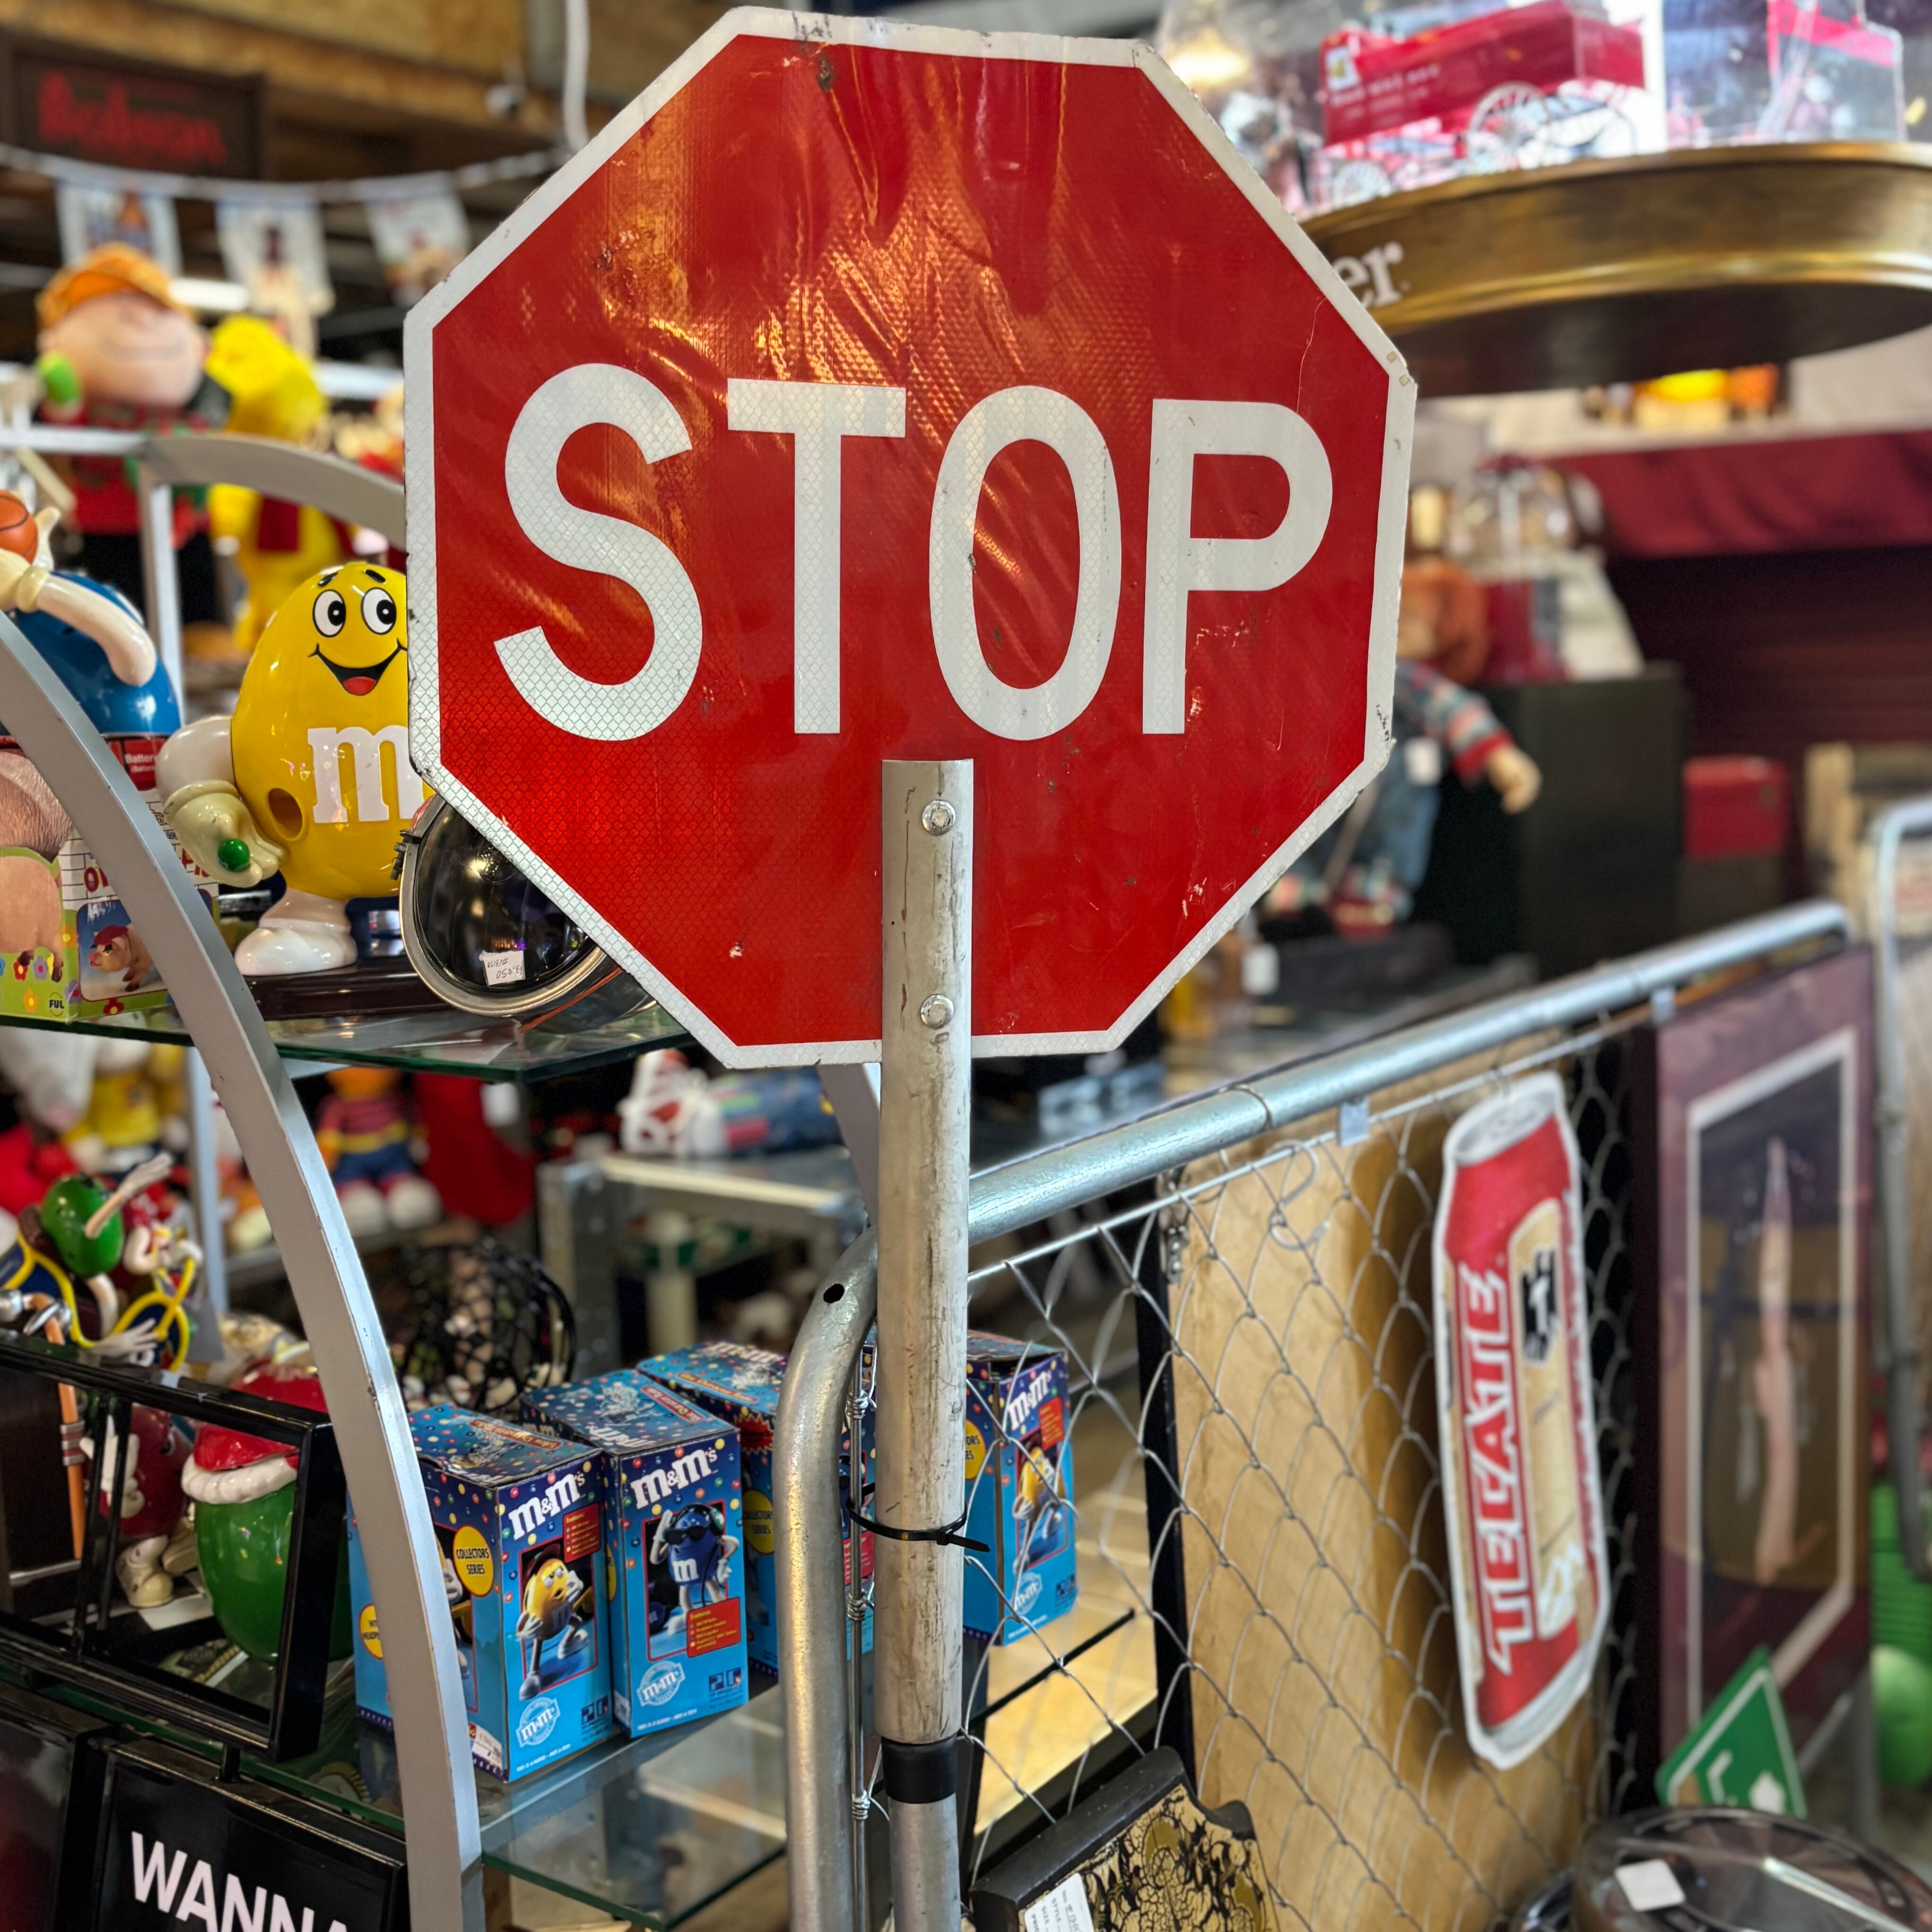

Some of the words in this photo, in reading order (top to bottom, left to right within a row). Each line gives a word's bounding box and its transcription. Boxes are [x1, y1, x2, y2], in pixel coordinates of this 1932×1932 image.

[493, 363, 1333, 741] STOP
[1458, 1259, 1535, 1676] TECATE
[456, 1548, 489, 1559] COLLECTORS
[466, 1564, 485, 1575] SERIES
[131, 1831, 347, 1932] WANN
